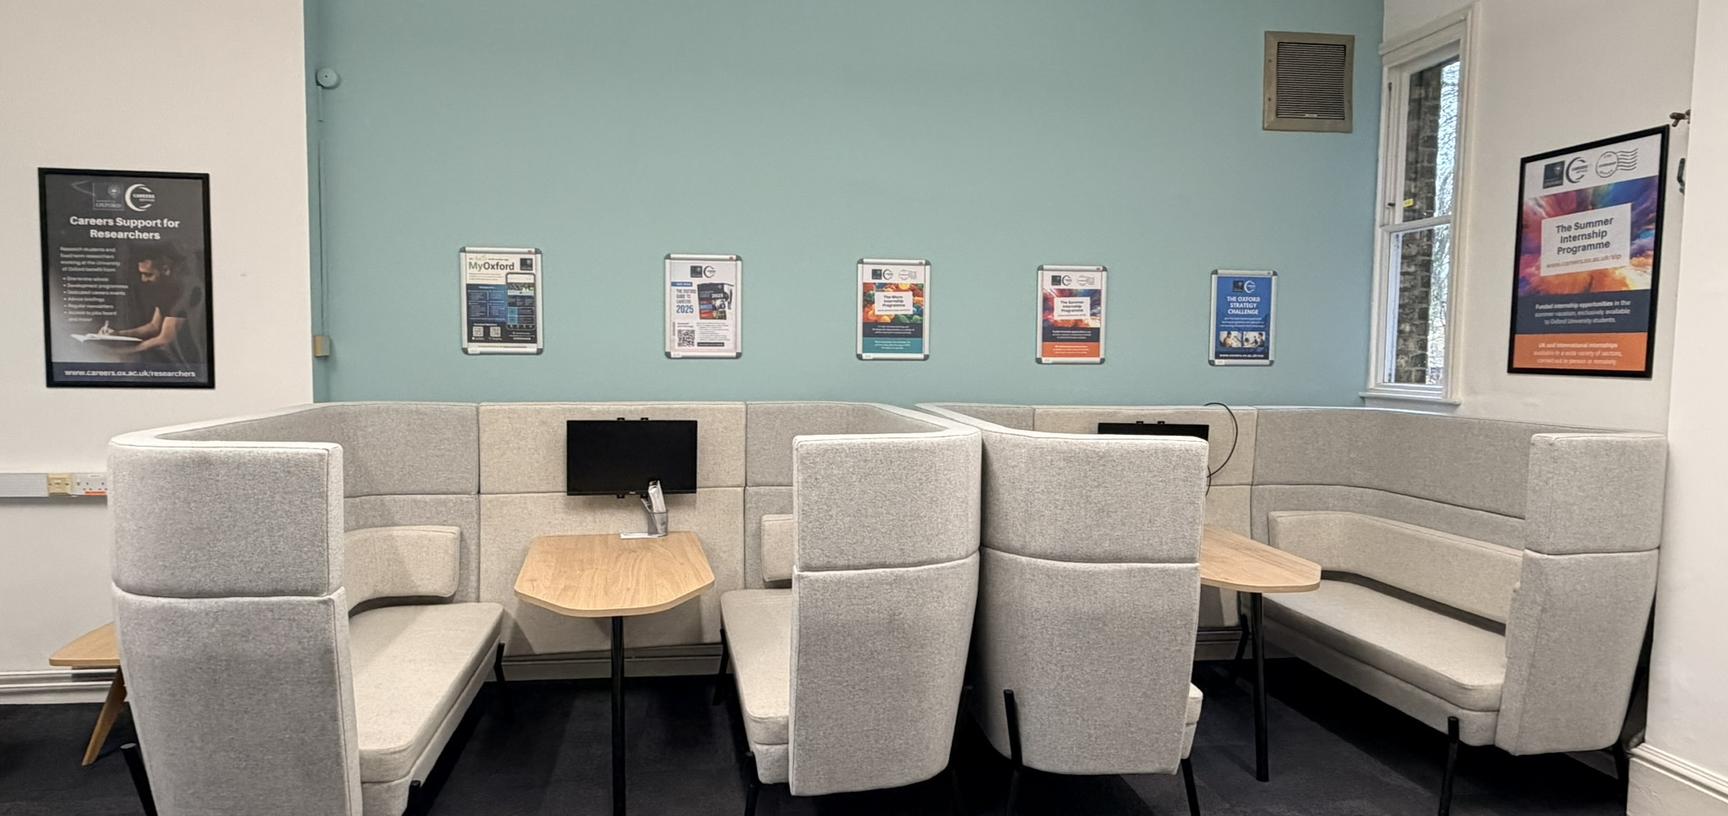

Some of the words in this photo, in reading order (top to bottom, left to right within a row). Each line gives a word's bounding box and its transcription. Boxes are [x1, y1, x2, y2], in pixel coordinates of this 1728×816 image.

[70, 216, 114, 226] Careers
[116, 217, 162, 229] Support
[163, 219, 180, 229] for
[1556, 223, 1572, 234] The
[1573, 217, 1614, 231] Summer
[90, 229, 161, 240] Researchers
[1560, 229, 1608, 244] Internship
[1557, 239, 1611, 255] Programme
[468, 261, 515, 272] MyOxford
[676, 304, 694, 314] 2025
[64, 369, 196, 378] www.careers.ox.ac.uk/researchers
